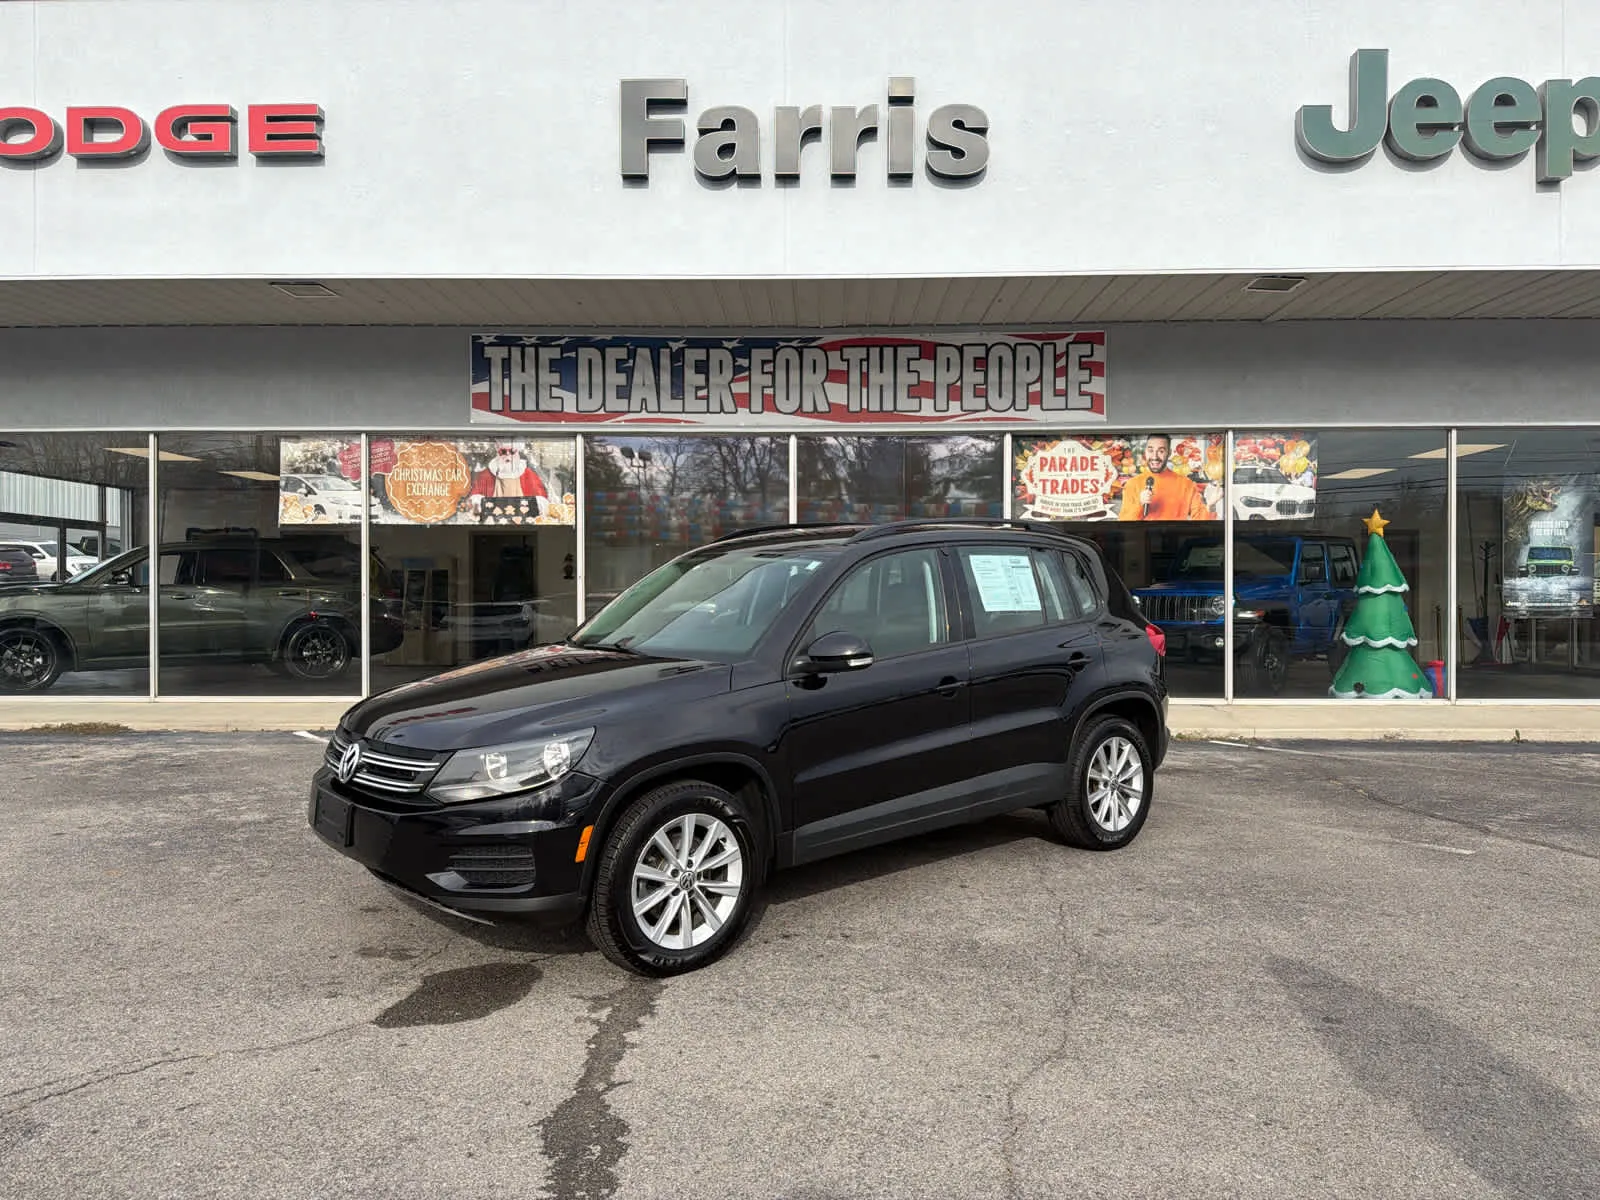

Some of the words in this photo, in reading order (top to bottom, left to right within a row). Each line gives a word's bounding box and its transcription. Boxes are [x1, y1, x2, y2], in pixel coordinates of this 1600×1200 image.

[1295, 48, 1600, 182] Jeep
[619, 76, 990, 182] Farris
[483, 344, 565, 413] THE
[576, 345, 738, 415] DEALER
[749, 345, 831, 415] FOR
[841, 343, 922, 414] THE
[933, 341, 1095, 413] PEOPLE
[1039, 456, 1100, 472] PARADE
[394, 468, 443, 481] CHRISTMAS
[445, 468, 462, 481] CAR
[406, 482, 451, 496] EXCHANGE
[1039, 479, 1100, 495] TRADES
